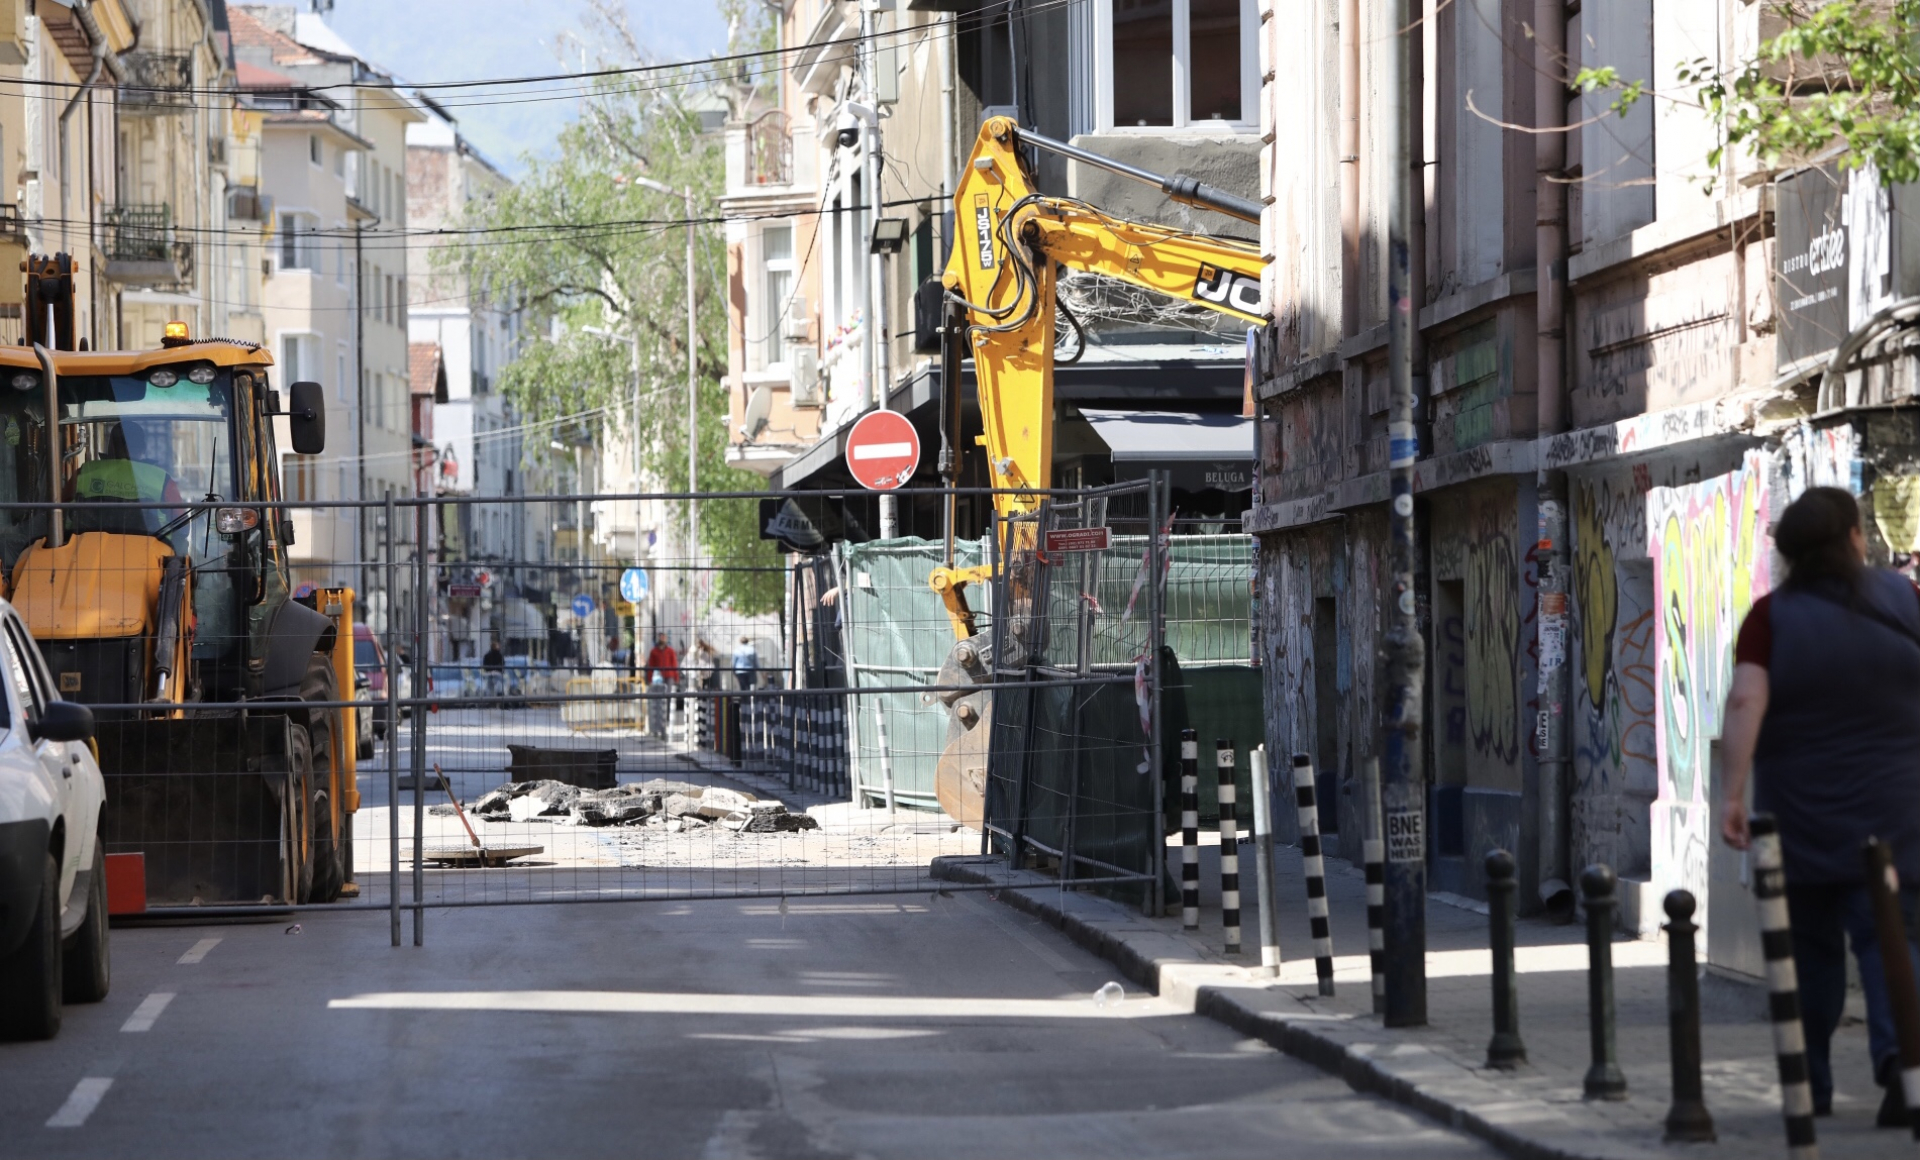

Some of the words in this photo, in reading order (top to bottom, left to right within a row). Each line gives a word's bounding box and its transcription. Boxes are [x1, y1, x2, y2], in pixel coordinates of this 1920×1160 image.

[1197, 271, 1262, 315] JC
[1205, 472, 1245, 483] BELUGA
[1390, 815, 1421, 835] BNE
[1391, 836, 1421, 847] WAS
[1391, 848, 1421, 859] HERE
